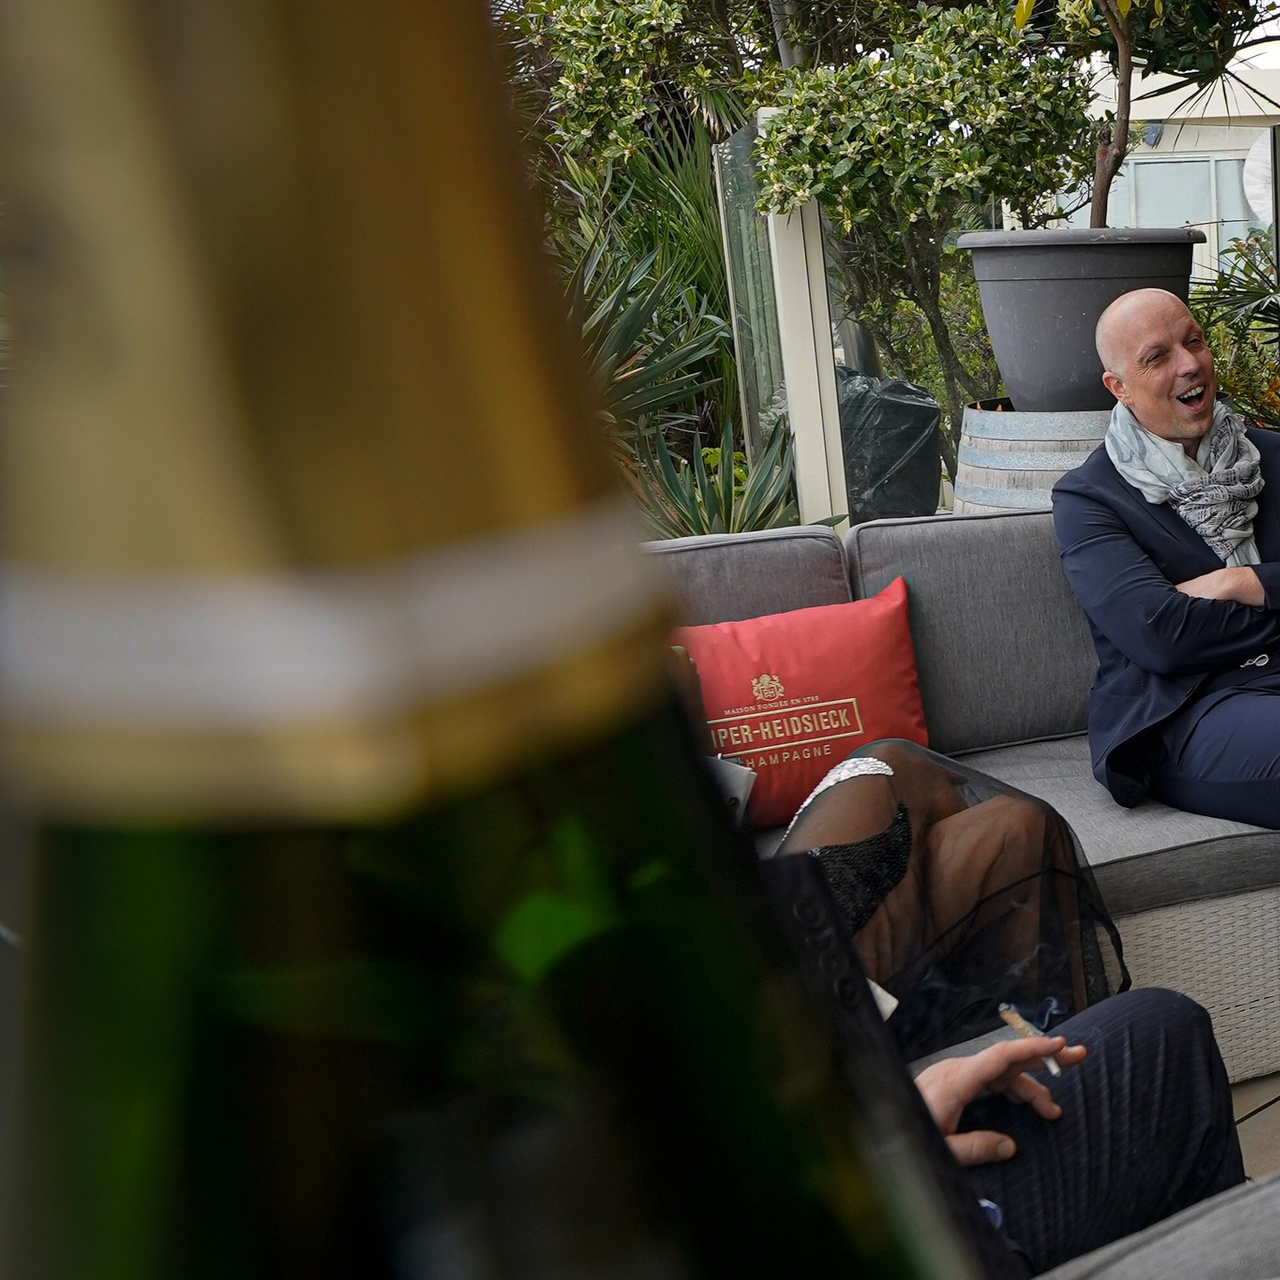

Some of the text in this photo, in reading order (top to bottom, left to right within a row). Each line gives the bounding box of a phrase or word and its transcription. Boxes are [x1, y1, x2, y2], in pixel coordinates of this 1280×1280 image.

[724, 705, 756, 716] MAISON
[710, 709, 852, 749] IPER-HEIDSIECK
[740, 744, 832, 768] HAMPAGNE
